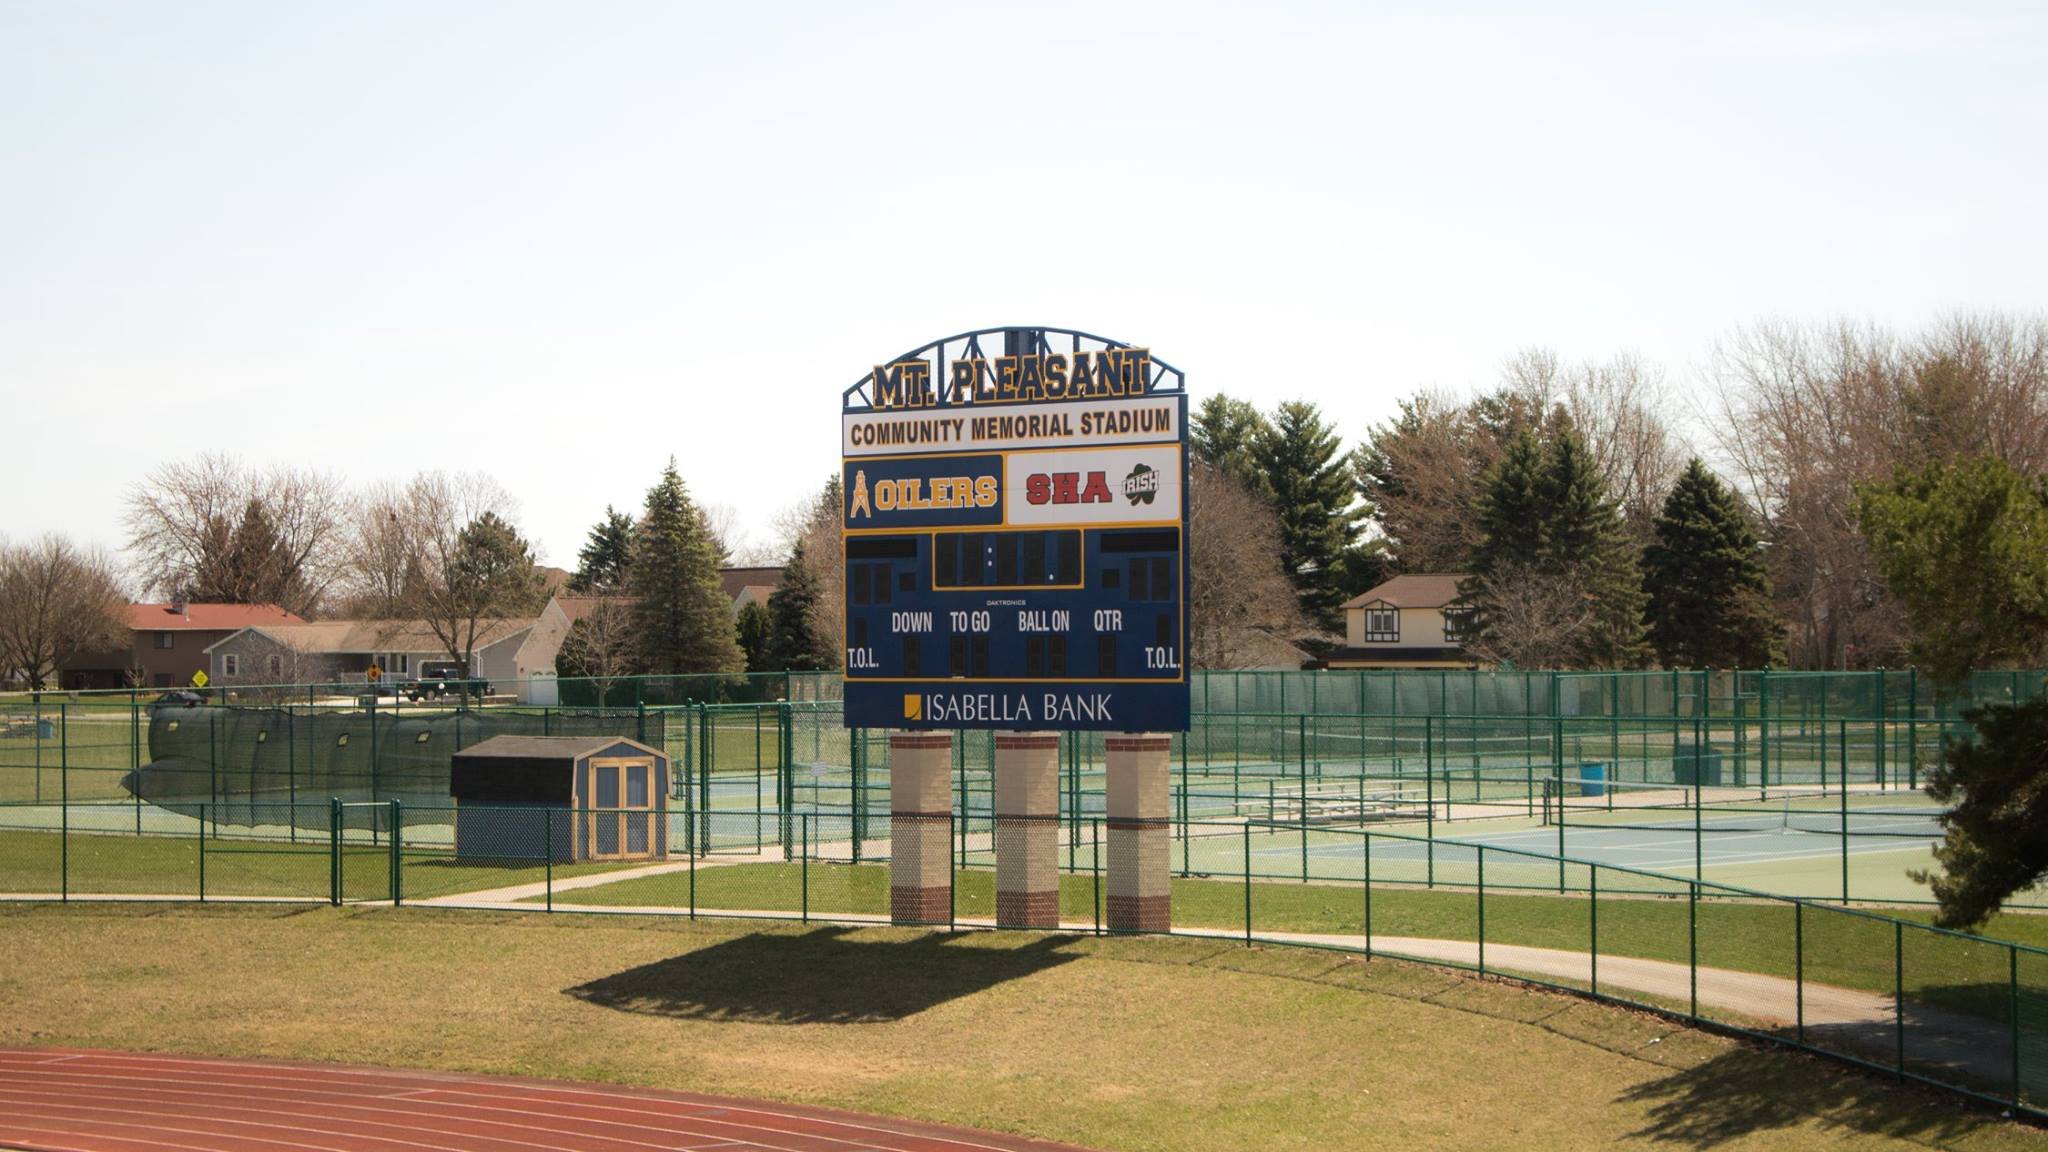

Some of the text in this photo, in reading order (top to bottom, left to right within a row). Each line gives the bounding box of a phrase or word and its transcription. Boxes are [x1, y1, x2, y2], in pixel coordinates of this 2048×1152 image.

[873, 348, 1150, 409] MT. PLEASANT
[851, 408, 1170, 446] COMMUNITY MEMORIAL STADIUM
[875, 475, 998, 511] OILERS
[1026, 471, 1112, 505] SHA
[1121, 470, 1159, 495] IRISH
[892, 611, 933, 633] DOWN
[950, 611, 991, 633] TO GO
[1018, 610, 1070, 632] BALL ON
[1094, 609, 1122, 631] QTR
[848, 647, 879, 668] T.O.L.
[1145, 647, 1181, 669] T.O.L.
[926, 694, 1113, 721] ISABELLA BANK
